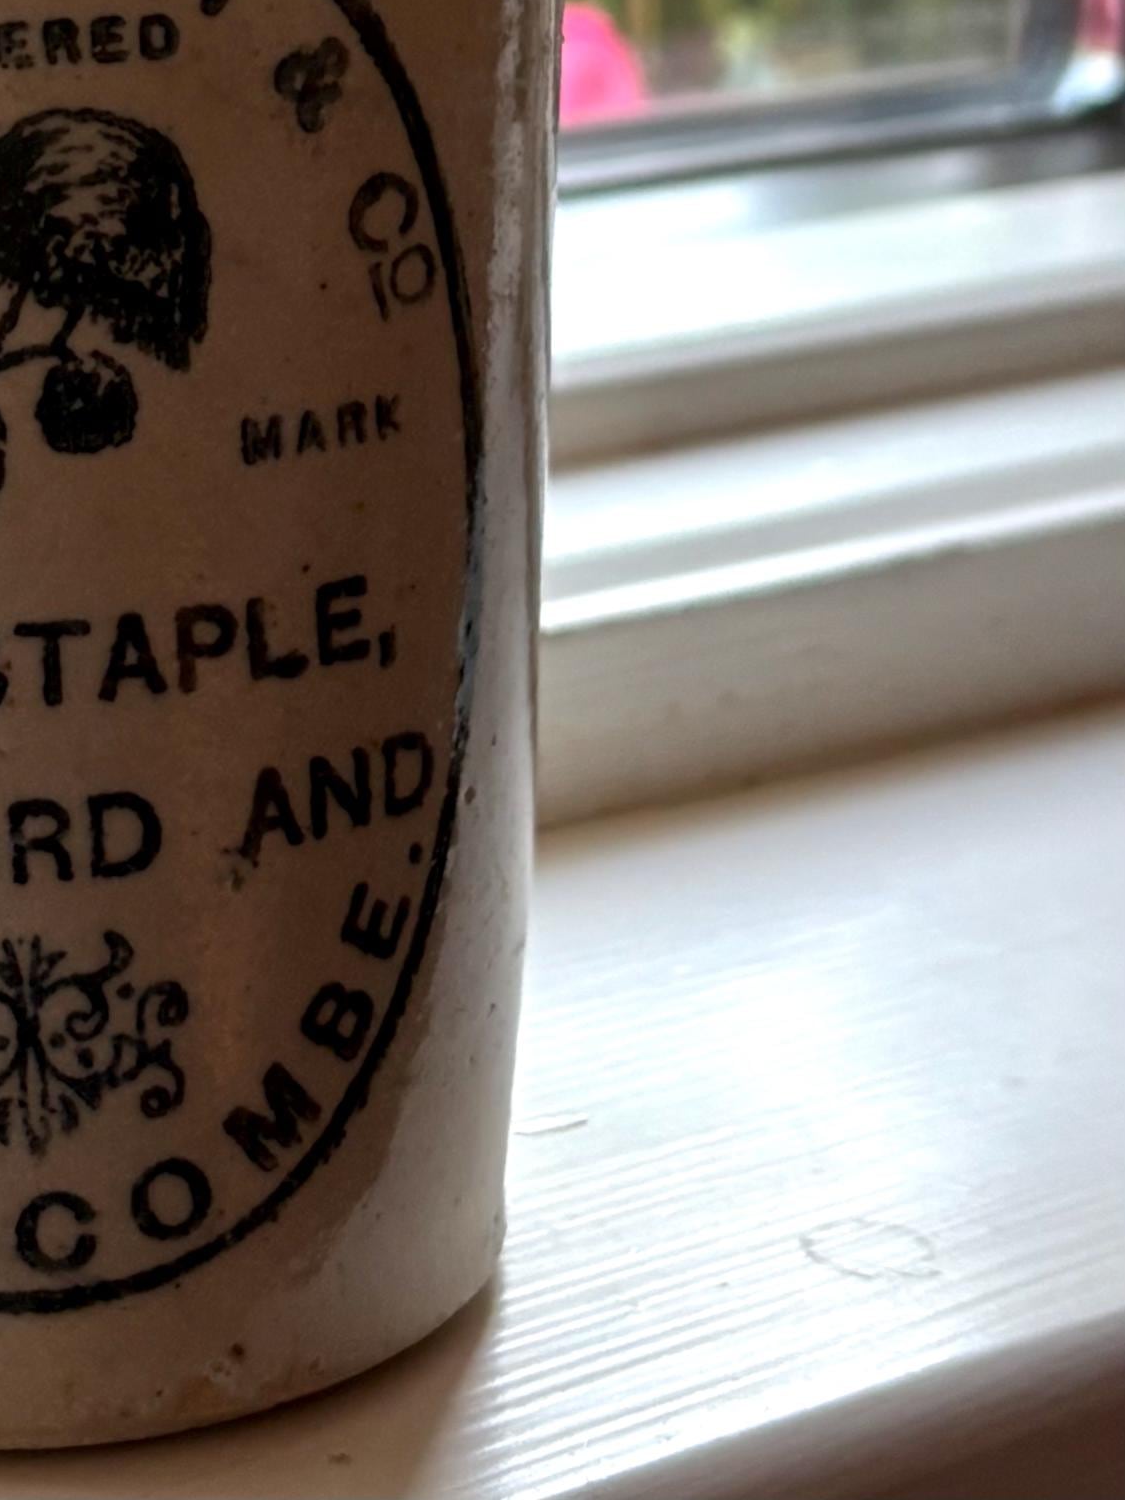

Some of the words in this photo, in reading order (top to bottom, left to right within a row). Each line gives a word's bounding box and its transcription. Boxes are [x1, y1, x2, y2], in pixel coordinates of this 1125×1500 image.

[274, 36, 350, 133] &
[240, 393, 402, 466] MARK
[238, 731, 434, 856] AND
